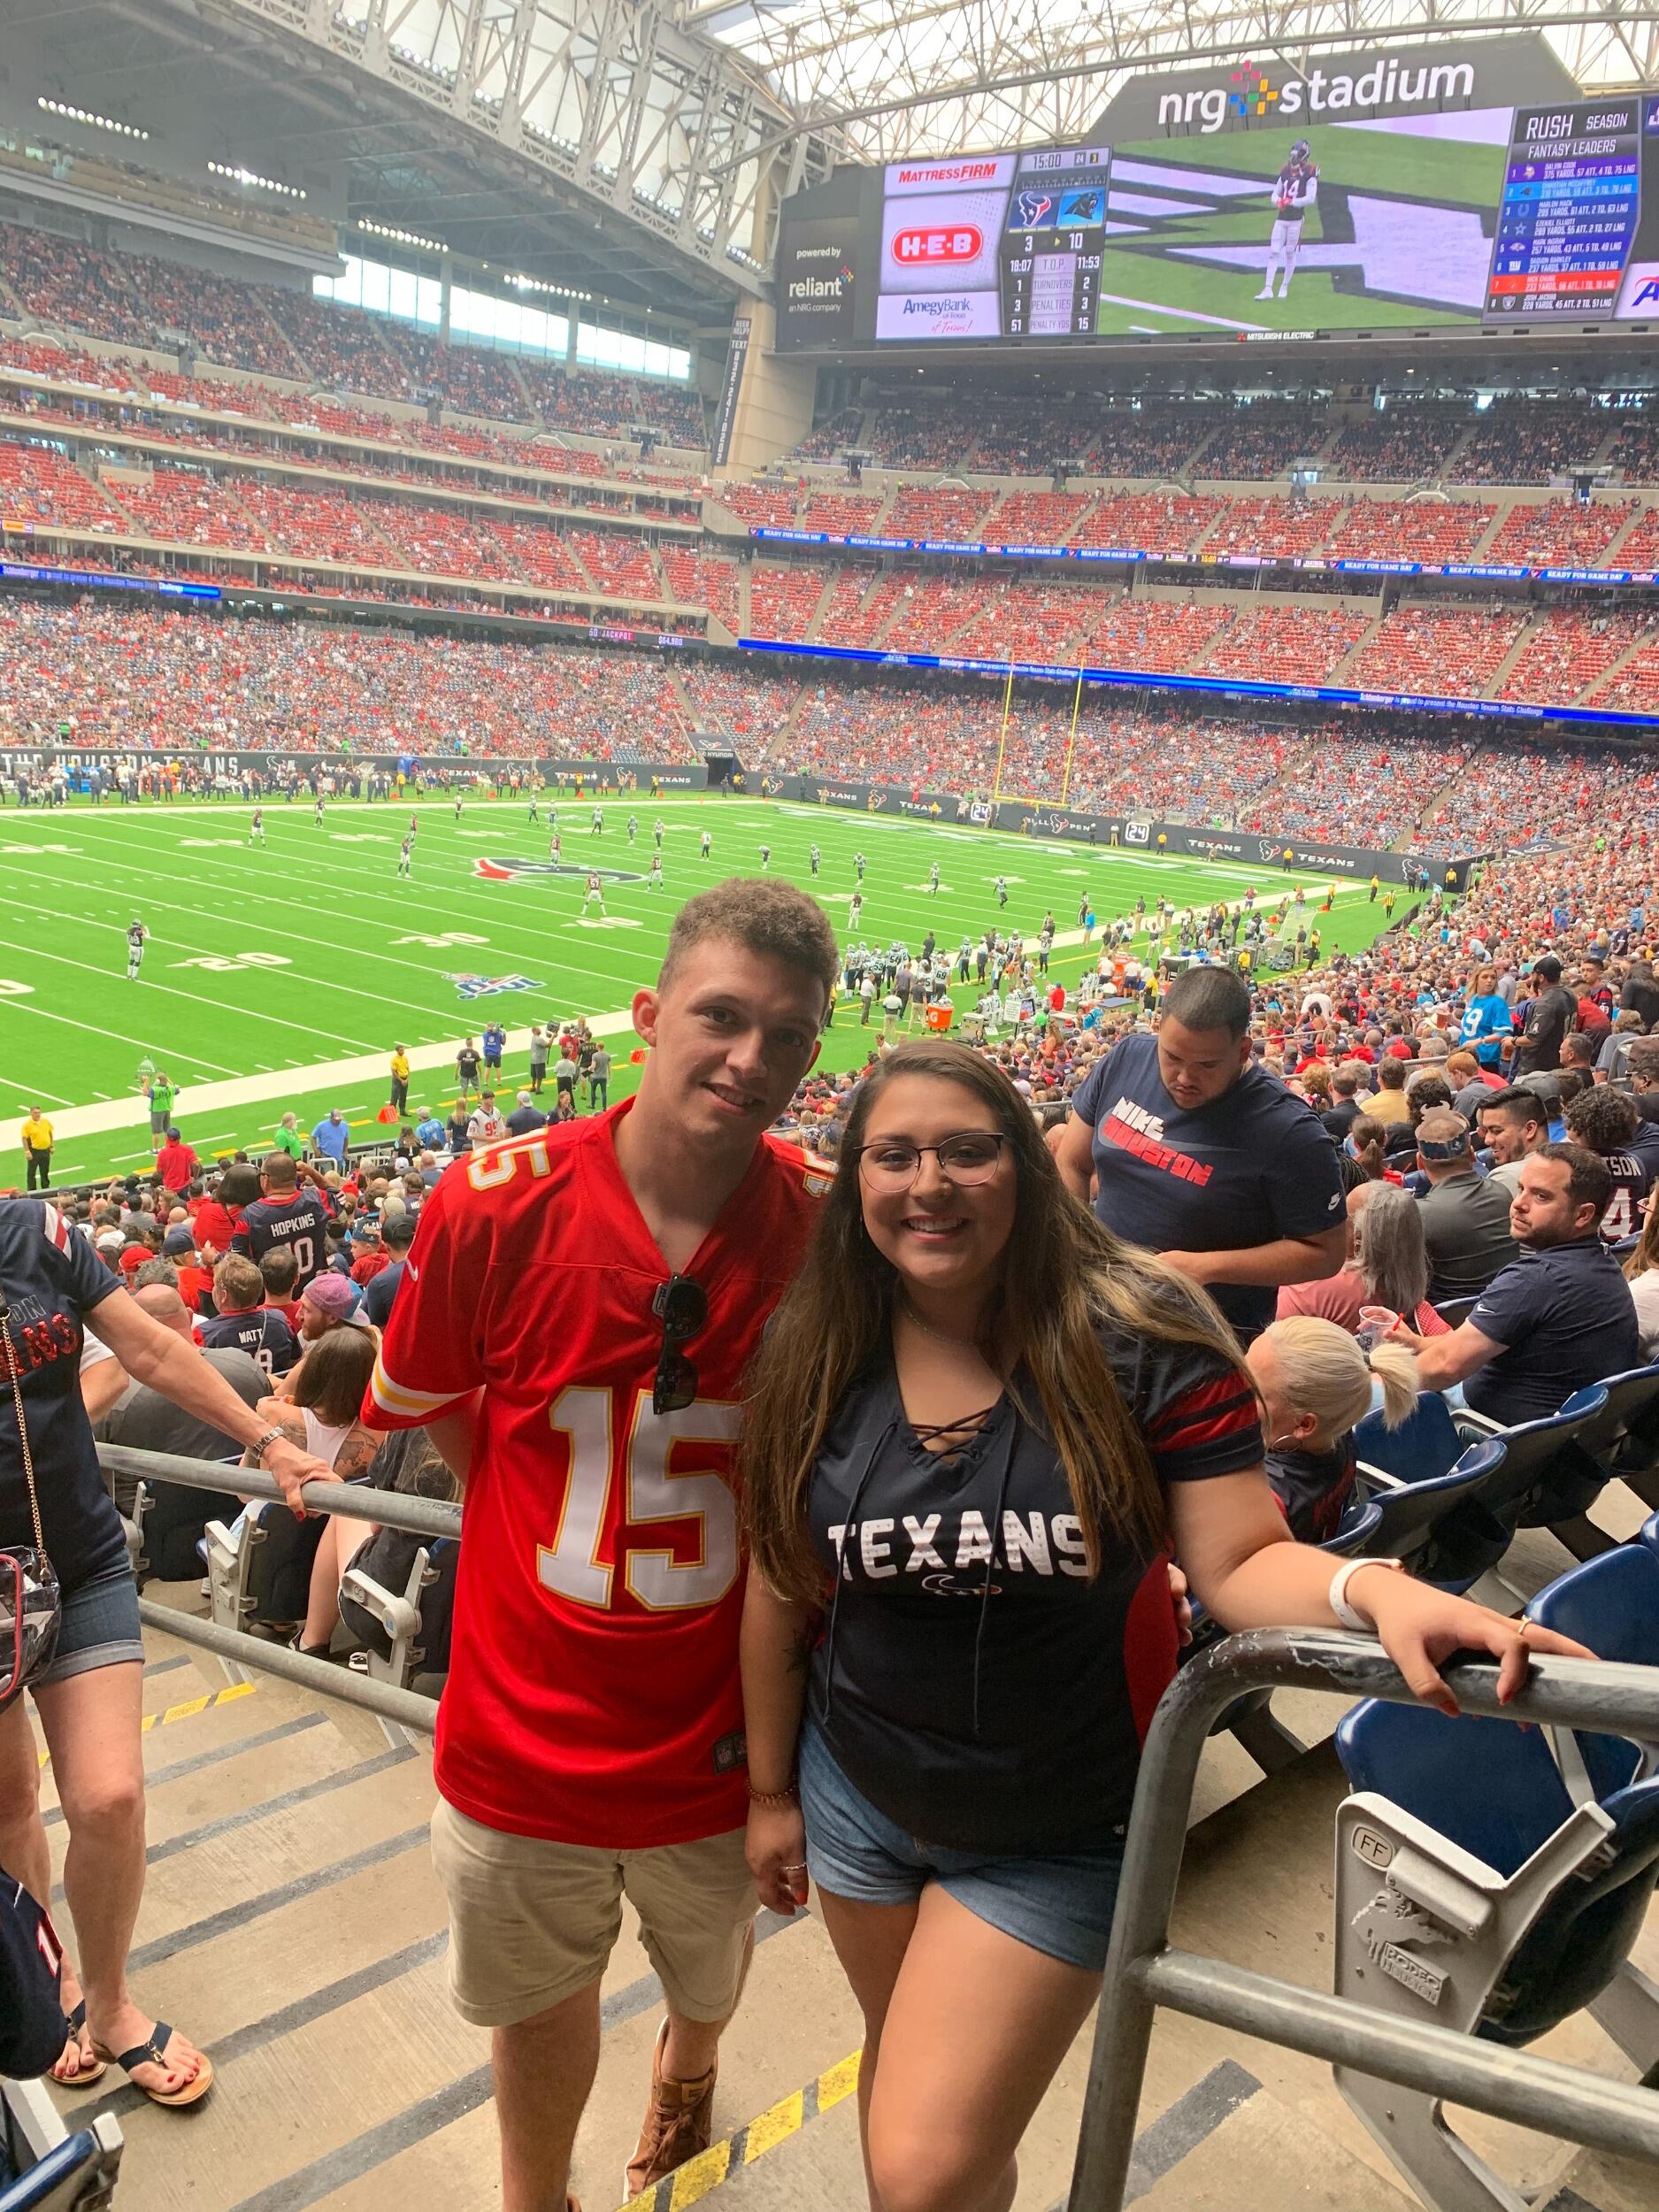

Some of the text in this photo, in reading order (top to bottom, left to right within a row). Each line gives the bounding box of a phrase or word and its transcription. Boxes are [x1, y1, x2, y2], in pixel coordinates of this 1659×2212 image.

[1158, 58, 1474, 133] nrg stadium
[1526, 113, 1628, 140] RUSH SEASON
[1528, 139, 1617, 159] FANTASY LEADERS
[1033, 154, 1061, 169] 15:00
[1025, 233, 1083, 252] 3 10
[796, 247, 841, 260] powered by
[1532, 246, 1541, 255] 257
[1010, 259, 1032, 273] 18:07
[1078, 256, 1100, 269] 11:53
[789, 277, 842, 297] reliant
[1017, 277, 1090, 292] 1 TURNOVERS 2
[812, 303, 841, 312] company
[1015, 297, 1088, 312] 3 PENALTIES 3
[1601, 298, 1612, 307] LNG
[1011, 319, 1021, 332] 51
[1030, 320, 1056, 329] PENALTY
[1079, 317, 1088, 330] 15
[1247, 331, 1314, 341] MITSUBISHI ELECTRIC
[731, 340, 748, 349] TEXT
[602, 630, 631, 641] JACKPOT
[1517, 706, 1543, 716] Challenge
[1128, 826, 1146, 839] 24
[1188, 839, 1241, 852] TEXANS
[1298, 853, 1355, 867] TEXANS
[1112, 1096, 1164, 1141] NIKE
[1102, 1114, 1214, 1187] HOUSTON
[1600, 1187, 1634, 1239] 4
[271, 1213, 315, 1238] HOPKINS
[239, 1328, 263, 1344] WATT
[536, 1386, 741, 1611] 15
[828, 1509, 1095, 1581] TEXANS
[1361, 1834, 1388, 1858] FF
[1386, 1949, 1442, 1990] RODEO
